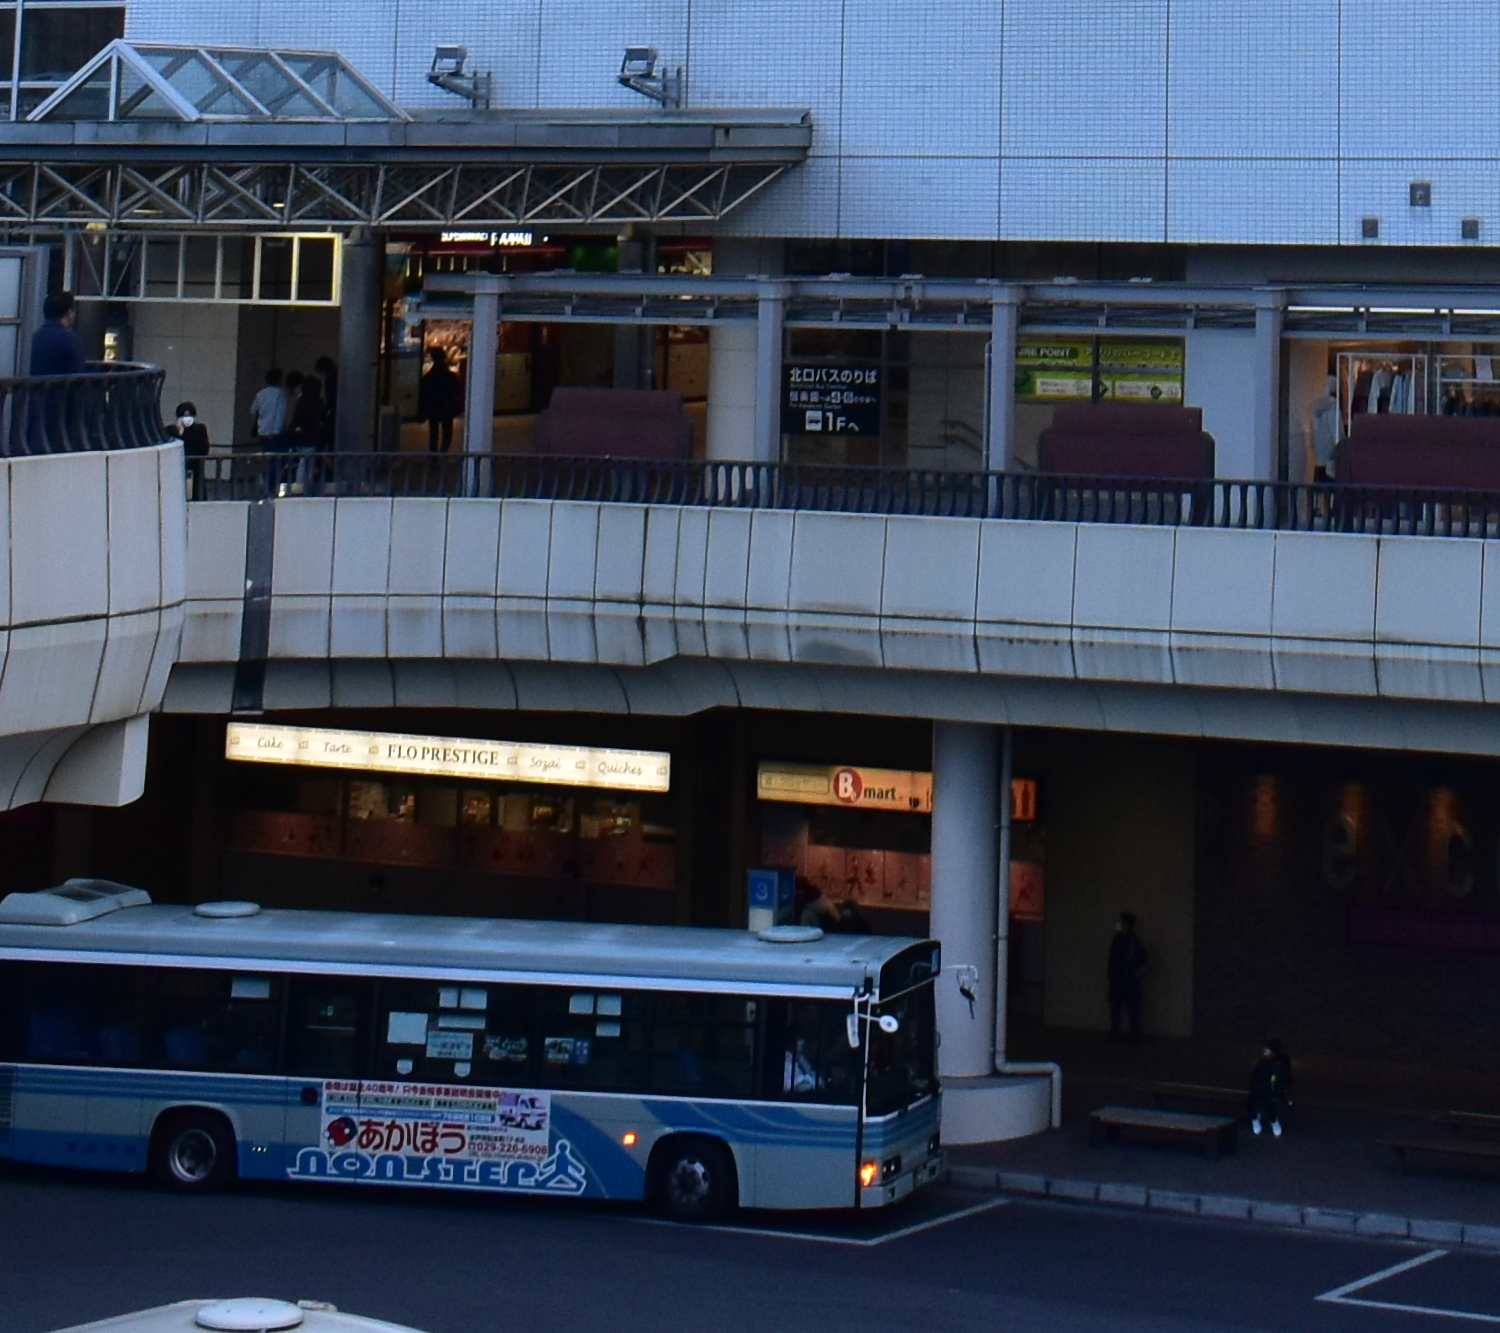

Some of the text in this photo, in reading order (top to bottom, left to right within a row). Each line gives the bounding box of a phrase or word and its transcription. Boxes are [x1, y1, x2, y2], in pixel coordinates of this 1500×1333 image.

[1039, 348, 1071, 357] POINT
[789, 367, 877, 384] 北口バスのりば
[257, 736, 284, 749] Cake
[323, 741, 353, 754] Tarte
[387, 743, 418, 761] FLO
[421, 745, 499, 766] PRESTIGE
[597, 761, 643, 777] Quiches
[864, 787, 896, 800] mart
[756, 883, 769, 900] 3
[357, 1119, 466, 1154] あかぼう
